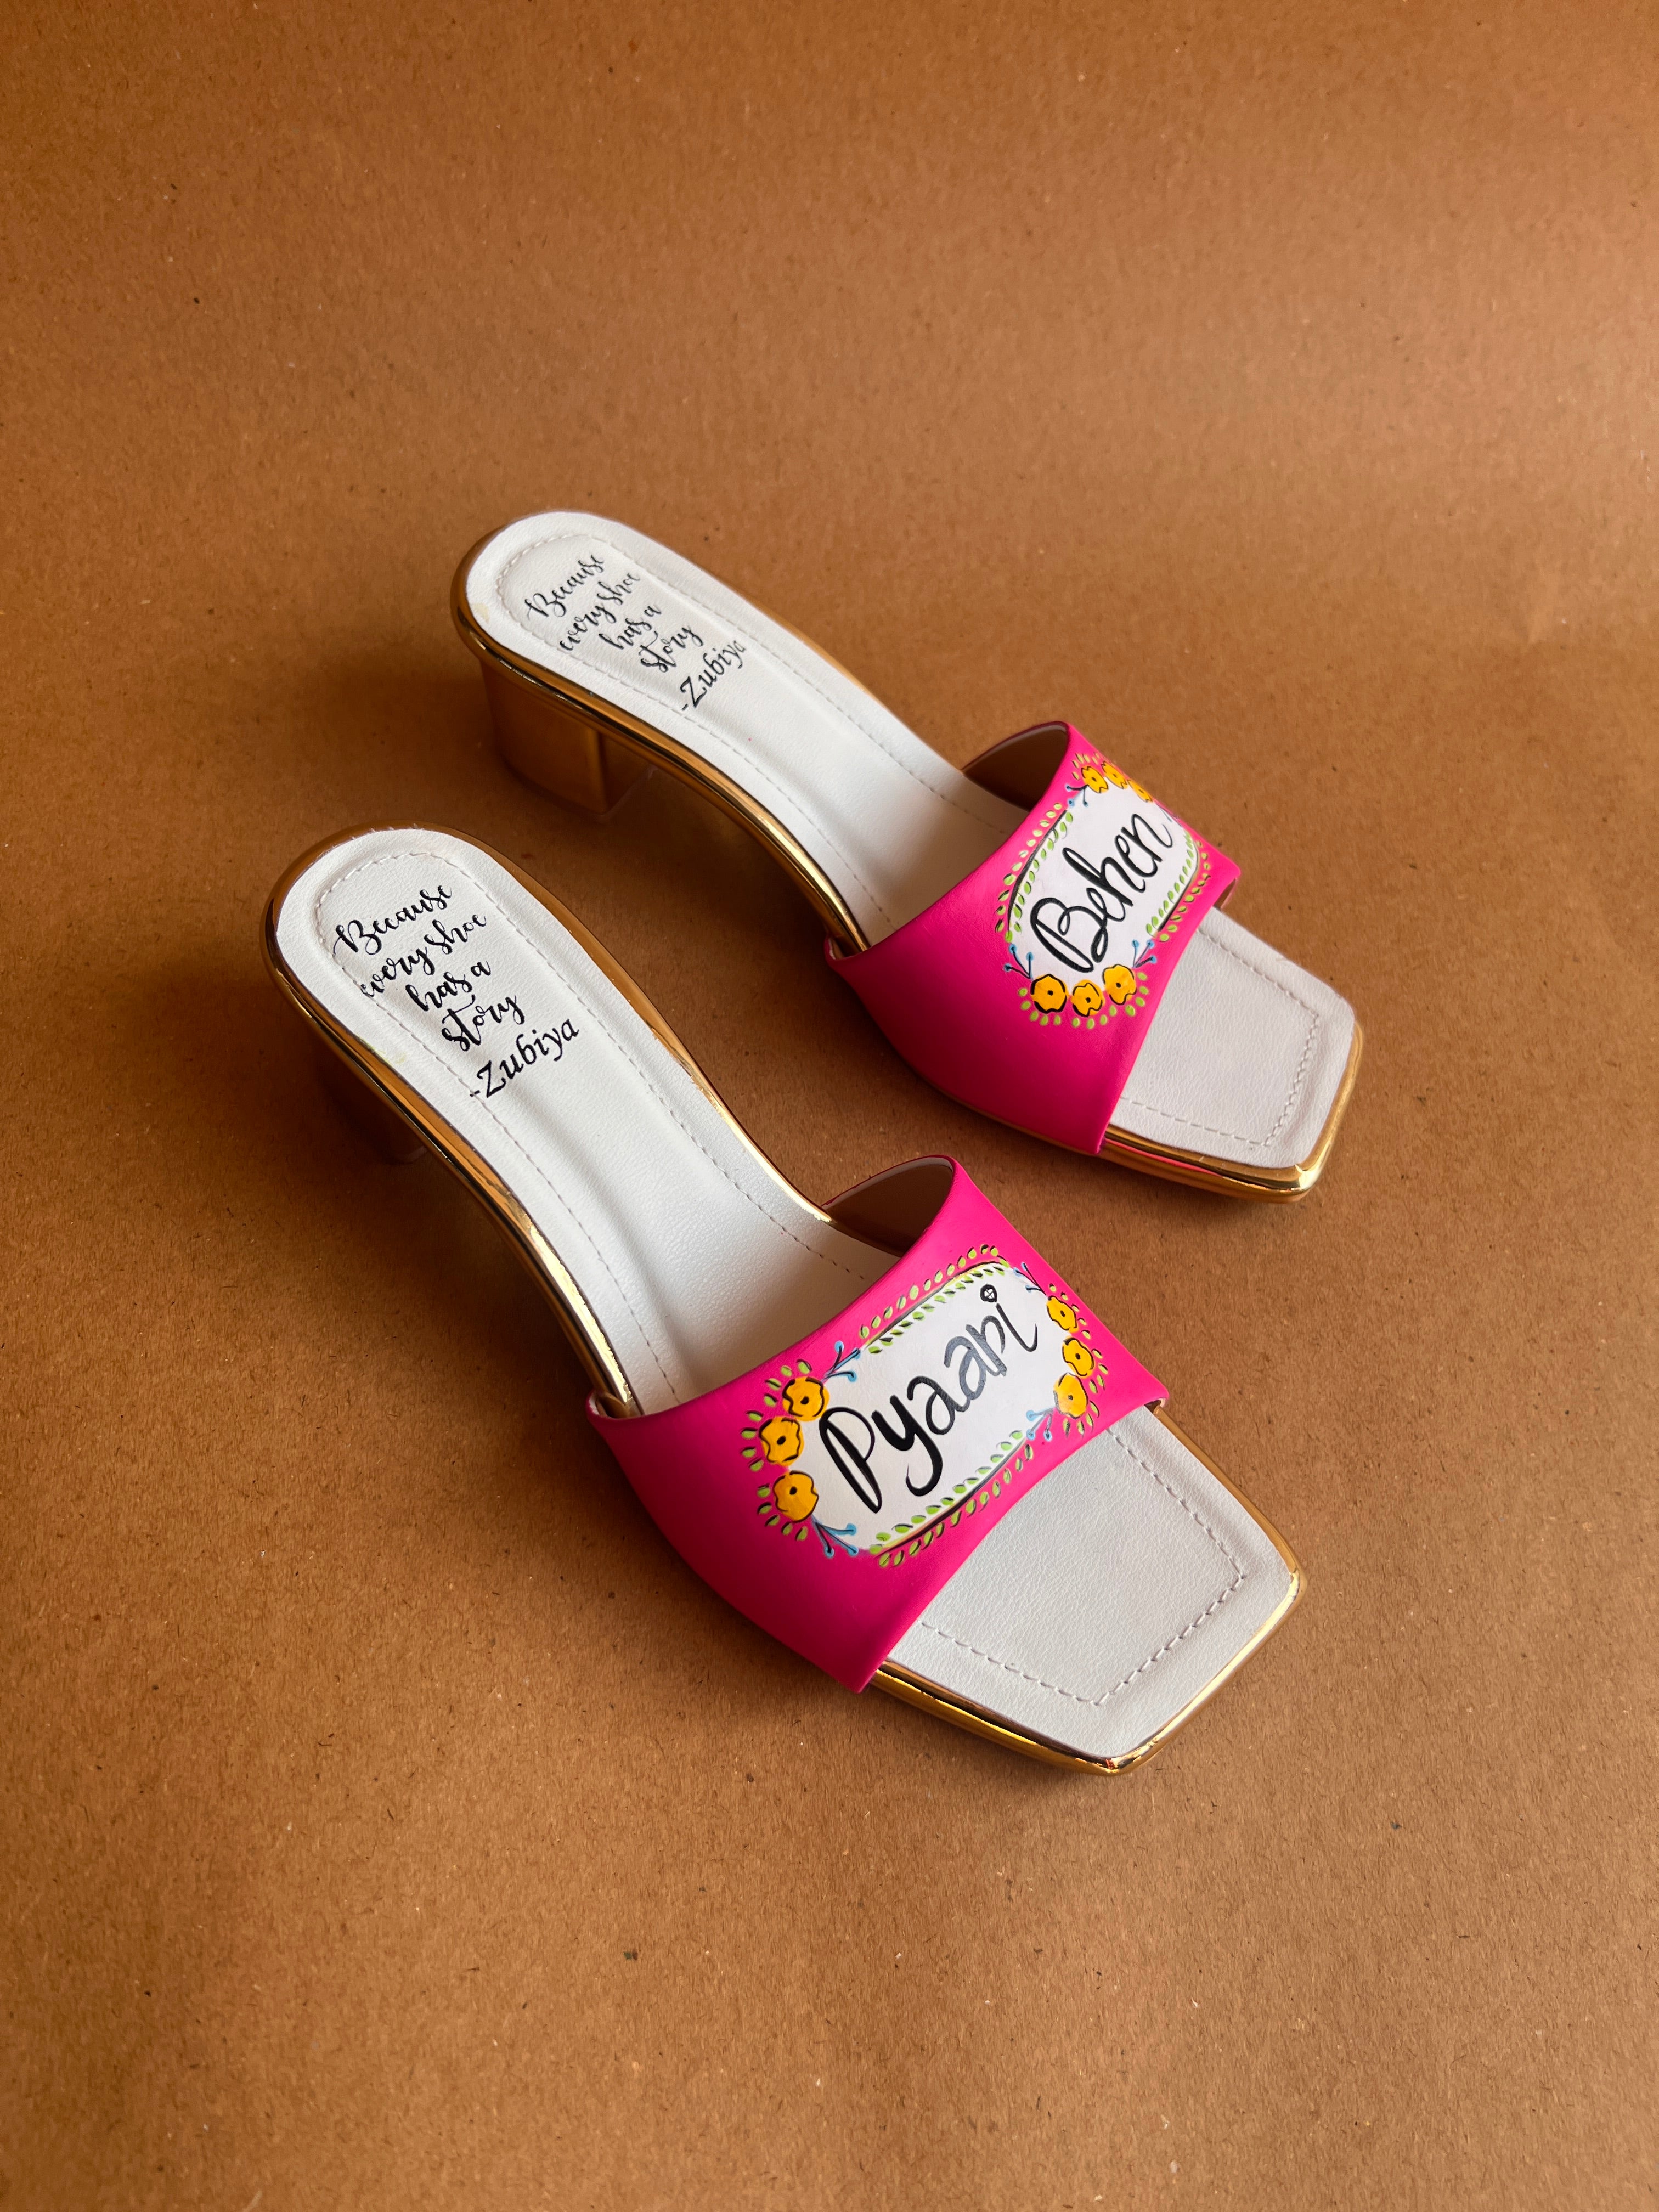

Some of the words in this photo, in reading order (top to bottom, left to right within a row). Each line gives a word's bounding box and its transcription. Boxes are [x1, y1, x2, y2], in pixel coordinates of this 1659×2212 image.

[524, 554, 604, 621] Because
[599, 617, 652, 651] has
[644, 603, 662, 623] a
[639, 624, 703, 673] story
[333, 885, 452, 955] Because
[1030, 814, 1173, 973] Behen
[360, 946, 435, 997] every
[424, 914, 487, 955] shoe
[405, 972, 473, 1012] has
[470, 961, 491, 977] a
[442, 994, 524, 1052] story
[470, 1019, 579, 1098] -Zubiya
[819, 1284, 1038, 1514] Pyaari
